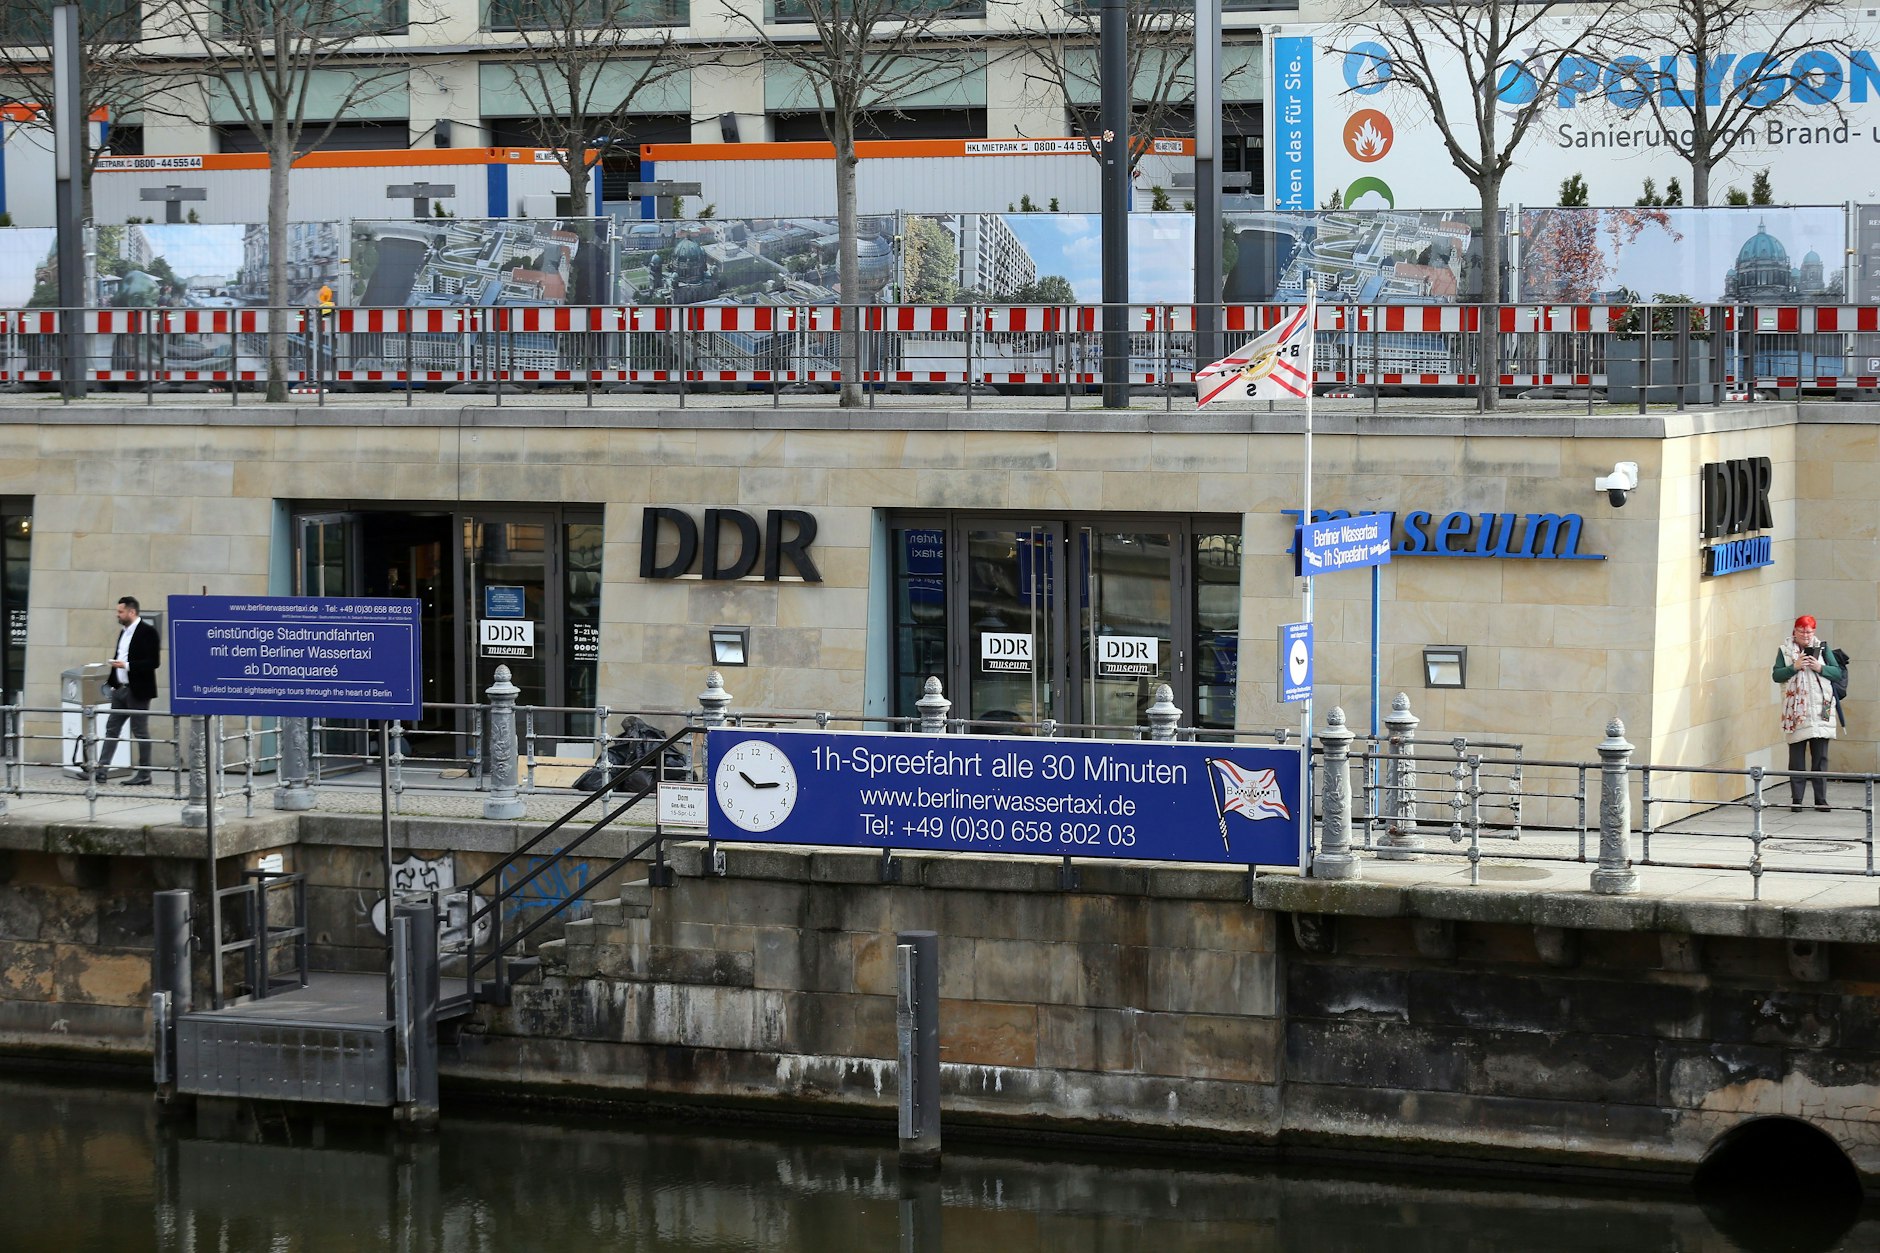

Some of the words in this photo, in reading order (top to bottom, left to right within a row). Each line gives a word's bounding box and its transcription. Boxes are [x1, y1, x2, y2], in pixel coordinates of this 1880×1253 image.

[1285, 55, 1301, 90] Sie.
[1285, 95, 1302, 125] für
[1557, 123, 1696, 153] Sanierung
[1767, 119, 1862, 146] Brand-
[967, 144, 981, 152] HKL
[982, 143, 1018, 152] MIETPARK
[1034, 141, 1056, 151] 0800
[1064, 142, 1075, 151] 44
[1285, 130, 1302, 163] das
[134, 159, 156, 168] 0800
[162, 159, 172, 168] 44
[173, 158, 188, 167] 555
[190, 158, 201, 167] 44
[1704, 456, 1773, 539] DDR
[1314, 528, 1340, 548] Berliner
[1341, 522, 1378, 543] Wassertaxi
[640, 507, 822, 582] DDR
[1324, 548, 1332, 567] 1h
[1333, 544, 1368, 568] Spreefahrt
[1706, 536, 1774, 576] museum
[230, 604, 318, 612] www.berlinerwassertaxi.de
[325, 604, 338, 613] Tel:
[354, 605, 373, 614] (0)30
[374, 606, 388, 614] 658
[388, 606, 402, 614] 802
[403, 606, 412, 614] 03
[207, 627, 274, 642] einstündige
[277, 626, 375, 642] Stadtrundfahrten
[488, 626, 525, 641] DDR
[211, 645, 228, 657] mit
[232, 645, 258, 658] dem
[260, 646, 304, 658] Berliner
[307, 646, 372, 660] Wassertaxi
[488, 646, 527, 655] museum
[990, 638, 1028, 656] DDR
[1107, 641, 1149, 658] DDR
[244, 662, 260, 675] ab
[263, 663, 338, 678] Domaquareé
[988, 660, 1031, 670] museum
[1106, 663, 1150, 674] museum
[202, 686, 226, 694] guided
[227, 686, 242, 694] boat
[244, 686, 286, 696] sightseeings
[306, 688, 332, 697] through
[332, 688, 344, 696] the
[345, 689, 364, 697] heart
[364, 689, 372, 697] of
[372, 689, 392, 697] Berlin
[751, 748, 760, 756] 12
[726, 764, 735, 772] 10
[812, 746, 982, 778] 1h-Spreefahrt
[992, 752, 1034, 778] alle
[1042, 754, 1075, 780] 30
[1084, 756, 1187, 784] Minuten
[723, 781, 728, 790] 9
[785, 782, 790, 791] 3
[1271, 790, 1277, 798] T
[727, 798, 733, 808] 8
[781, 798, 786, 807] 4
[860, 786, 1136, 816] www.berlinerwassertaxi.de
[739, 810, 744, 819] 7
[753, 814, 759, 824] 6
[770, 811, 775, 820] 5
[1248, 809, 1254, 817] S
[860, 814, 894, 836] Tel:
[902, 816, 944, 838] +49
[951, 816, 1004, 842] (0)30
[1011, 820, 1053, 842] 658
[1060, 823, 1101, 845] 802
[1108, 824, 1136, 847] 03
